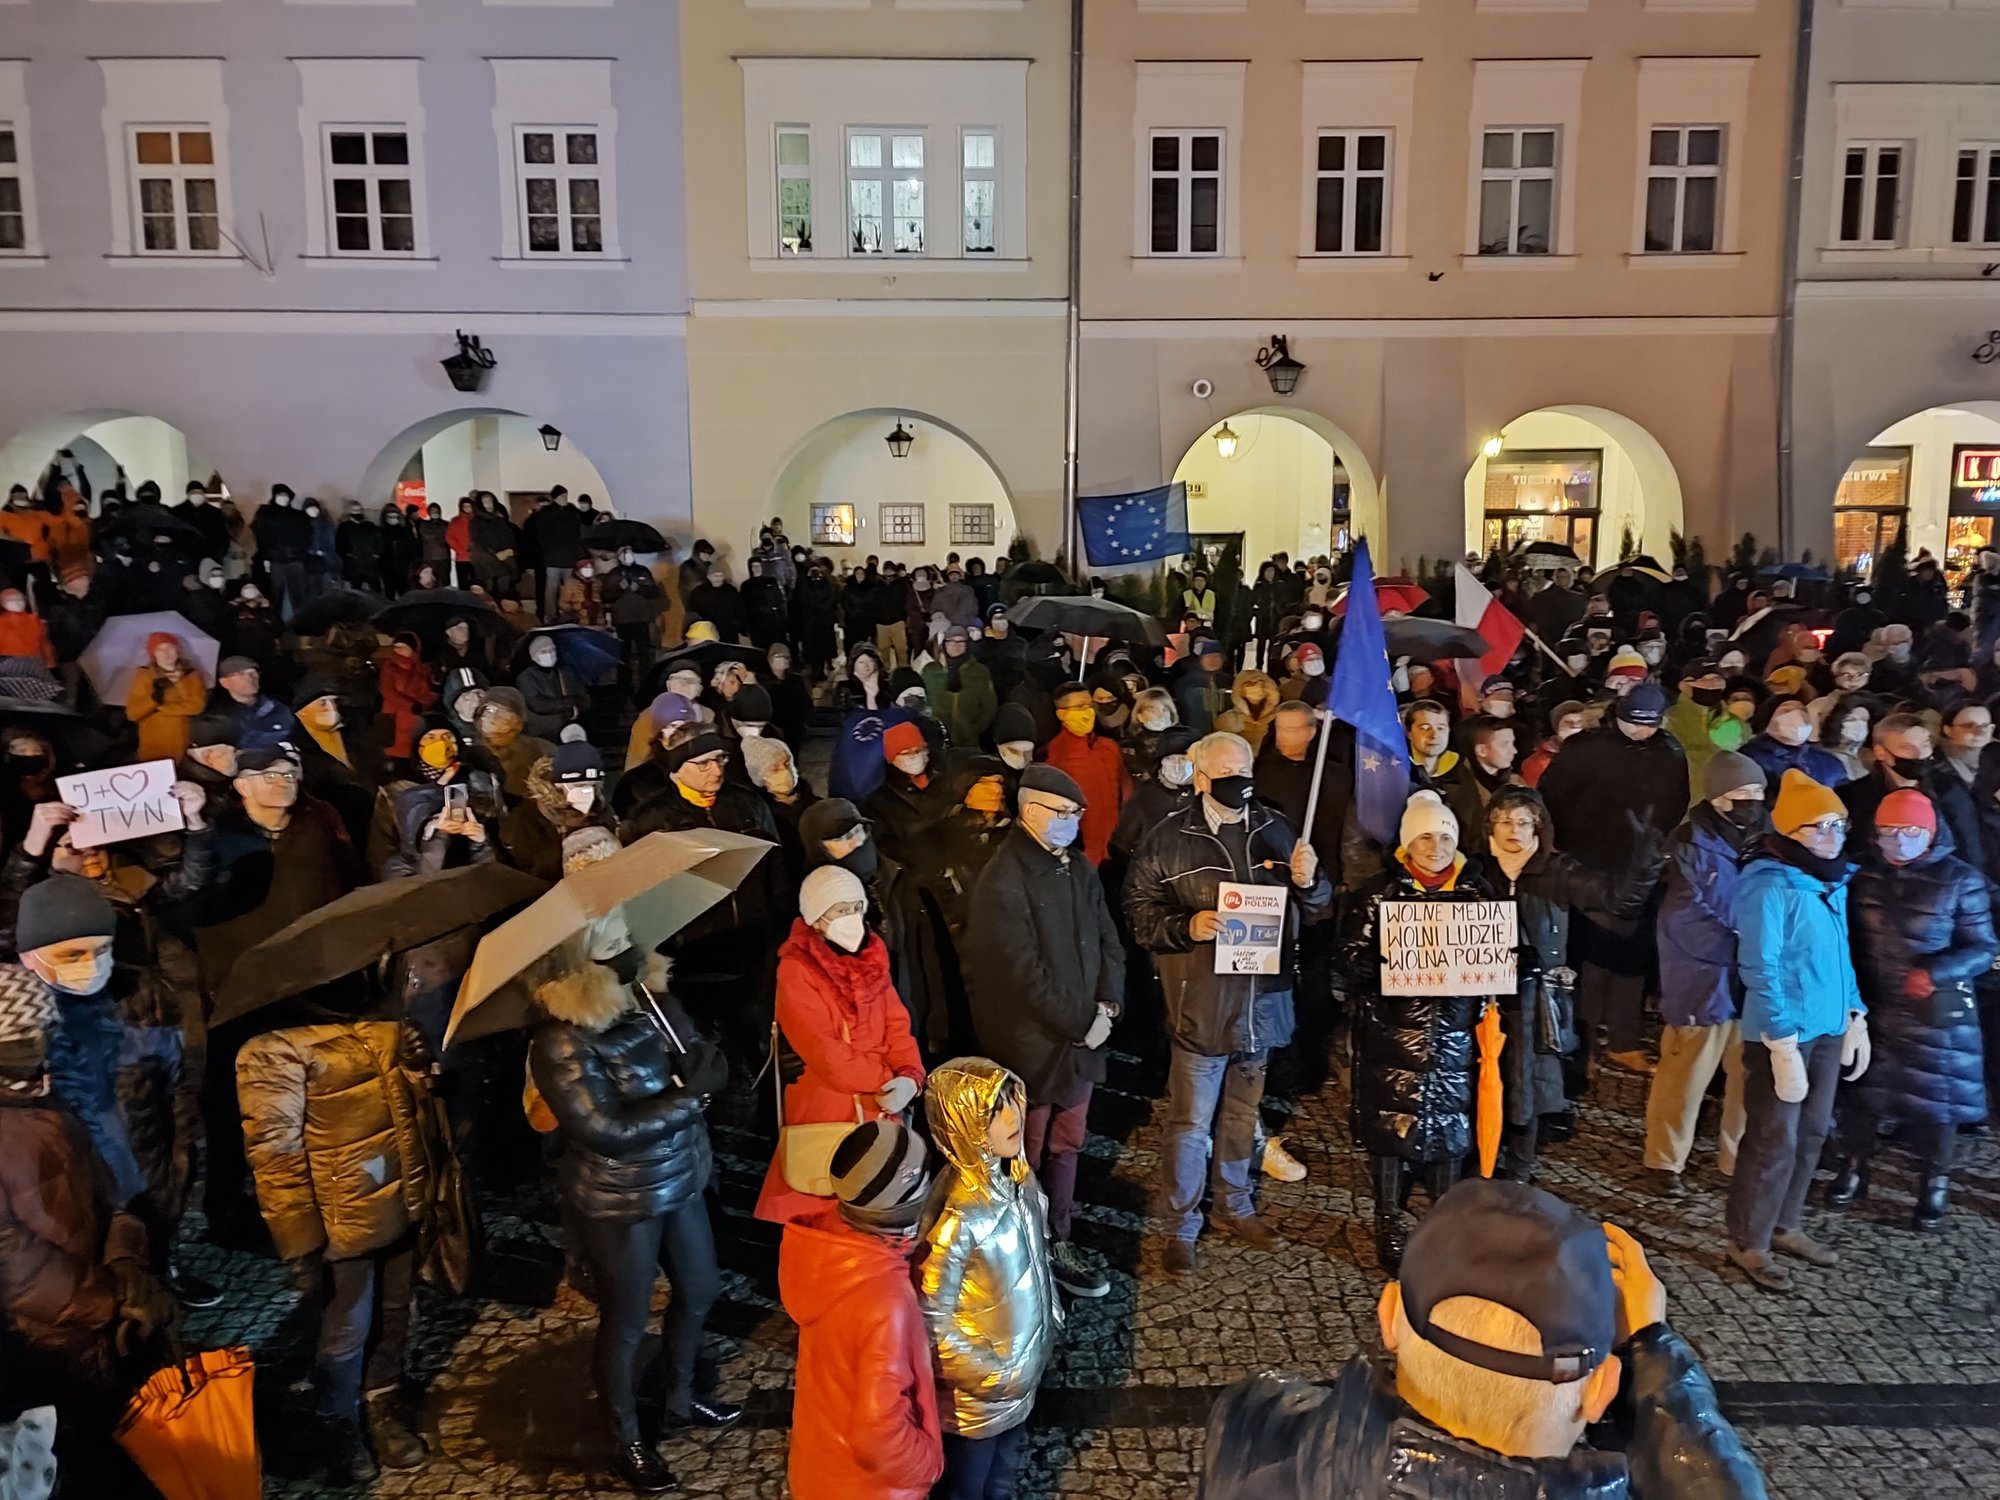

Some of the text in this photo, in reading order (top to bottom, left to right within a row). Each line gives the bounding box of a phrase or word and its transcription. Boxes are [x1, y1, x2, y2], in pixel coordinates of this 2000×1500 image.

[1187, 484, 1201, 493] 39
[90, 798, 165, 835] TVN
[1244, 900, 1280, 908] POLSKA
[1386, 903, 1443, 923] WOLNE
[1387, 925, 1440, 948] WOLNI
[1388, 946, 1516, 971] WOLNA POLSKA
